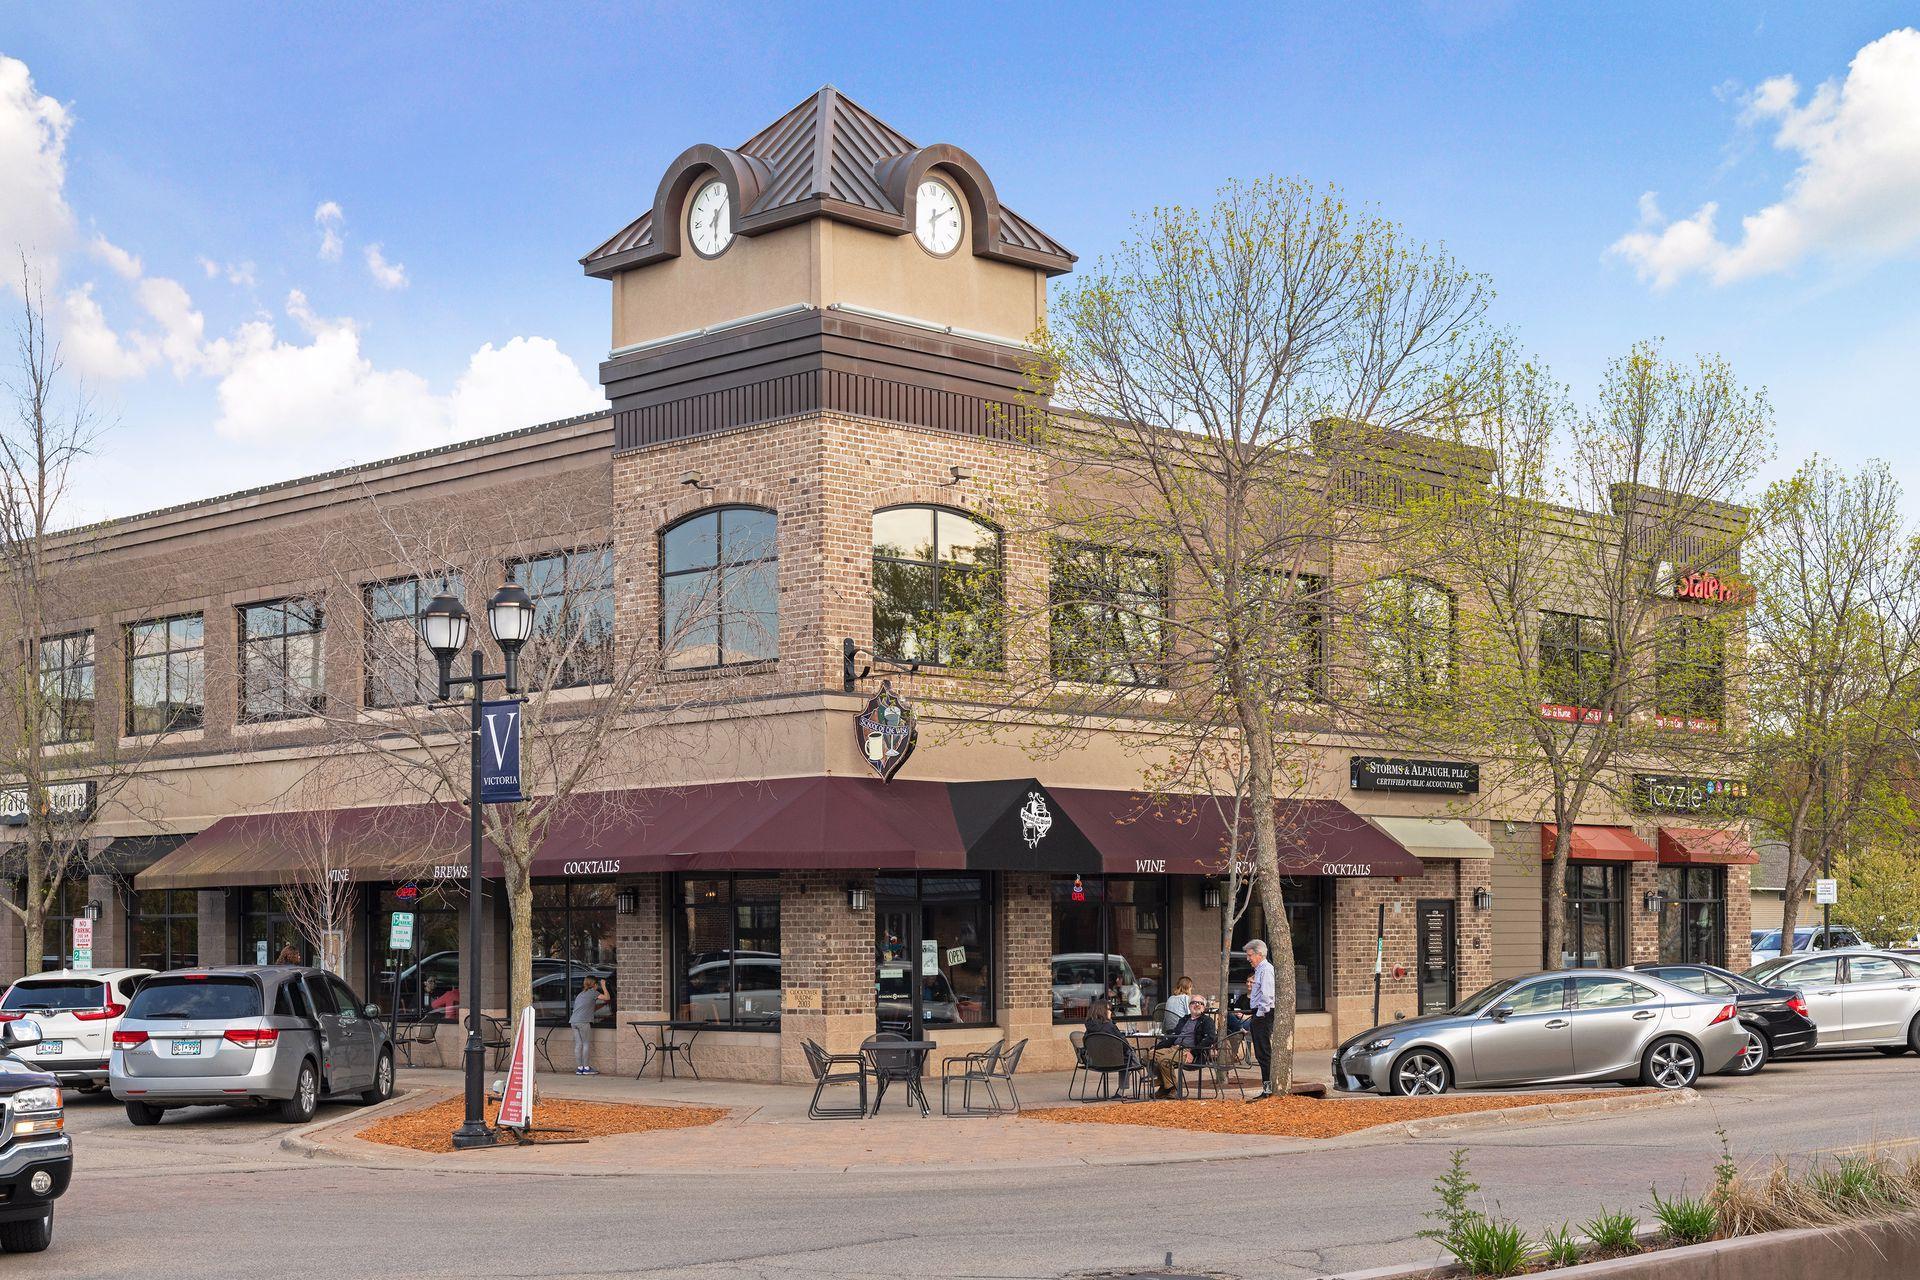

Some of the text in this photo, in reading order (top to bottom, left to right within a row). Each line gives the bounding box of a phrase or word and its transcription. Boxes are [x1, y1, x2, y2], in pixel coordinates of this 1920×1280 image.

[484, 712, 518, 772] V
[1404, 767, 1410, 775] &
[1451, 768, 1470, 779] PLLC
[483, 776, 518, 786] VICTORIA
[1376, 777, 1464, 789] CERTIFIED PUBLIC ACCOUNTANTS
[433, 865, 468, 878] BREWS
[563, 860, 621, 875] COCKTAILS
[1135, 859, 1166, 873] WINE
[1321, 862, 1371, 876] COCKTAILS
[1071, 891, 1085, 901] OPEN
[74, 951, 79, 960] 2
[948, 948, 965, 964] OPEN
[797, 1000, 811, 1008] 2003
